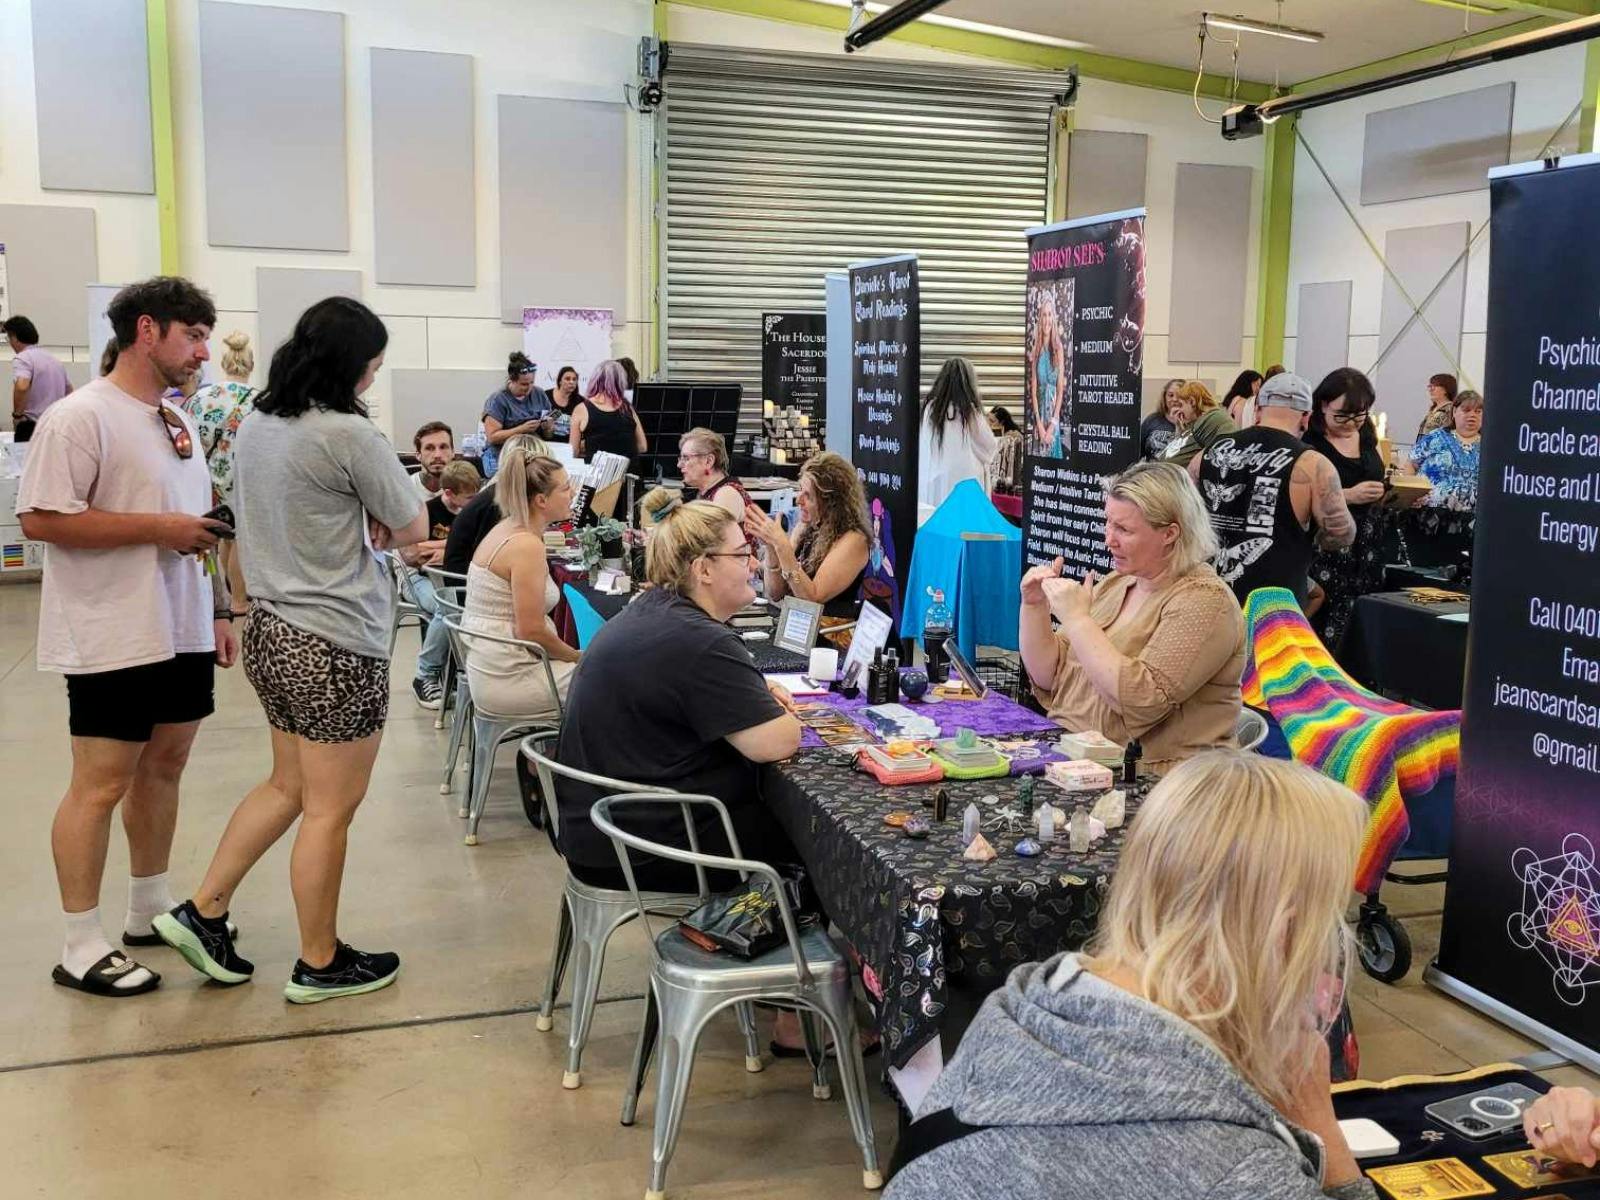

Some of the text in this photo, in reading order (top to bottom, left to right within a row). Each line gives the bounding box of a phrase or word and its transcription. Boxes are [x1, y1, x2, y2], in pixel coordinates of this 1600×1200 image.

[889, 270, 911, 293] Tarot
[1081, 306, 1114, 321] PSYCHIC
[1080, 340, 1113, 354] MEDIUM
[1079, 374, 1118, 388] INTUITIVE
[1078, 390, 1134, 405] TAROT READER
[1078, 423, 1131, 440] CRYSTAL BALL
[1518, 422, 1576, 456] Oracle
[1078, 440, 1112, 456] READING
[1204, 437, 1294, 476] Butterfly
[1034, 465, 1056, 479] Sharon
[1080, 472, 1087, 483] is
[1088, 475, 1093, 484] a
[1502, 465, 1556, 498] House
[1559, 473, 1592, 503] and
[1033, 495, 1044, 507] She
[1045, 497, 1058, 510] has
[1058, 500, 1073, 513] been
[1084, 487, 1102, 502] Tarot
[1030, 509, 1046, 524] Spirit
[1046, 511, 1062, 525] from
[1063, 514, 1073, 528] her
[1073, 517, 1090, 534] early
[1540, 511, 1599, 552] Energy
[1030, 524, 1052, 539] Sharon
[1052, 529, 1064, 541] will
[1064, 531, 1080, 546] focus
[1081, 538, 1091, 548] on
[1064, 546, 1074, 559] the
[1074, 549, 1091, 564] Auric
[1092, 553, 1110, 568] Field
[1529, 597, 1561, 631] Call
[1562, 647, 1600, 684] Ema
